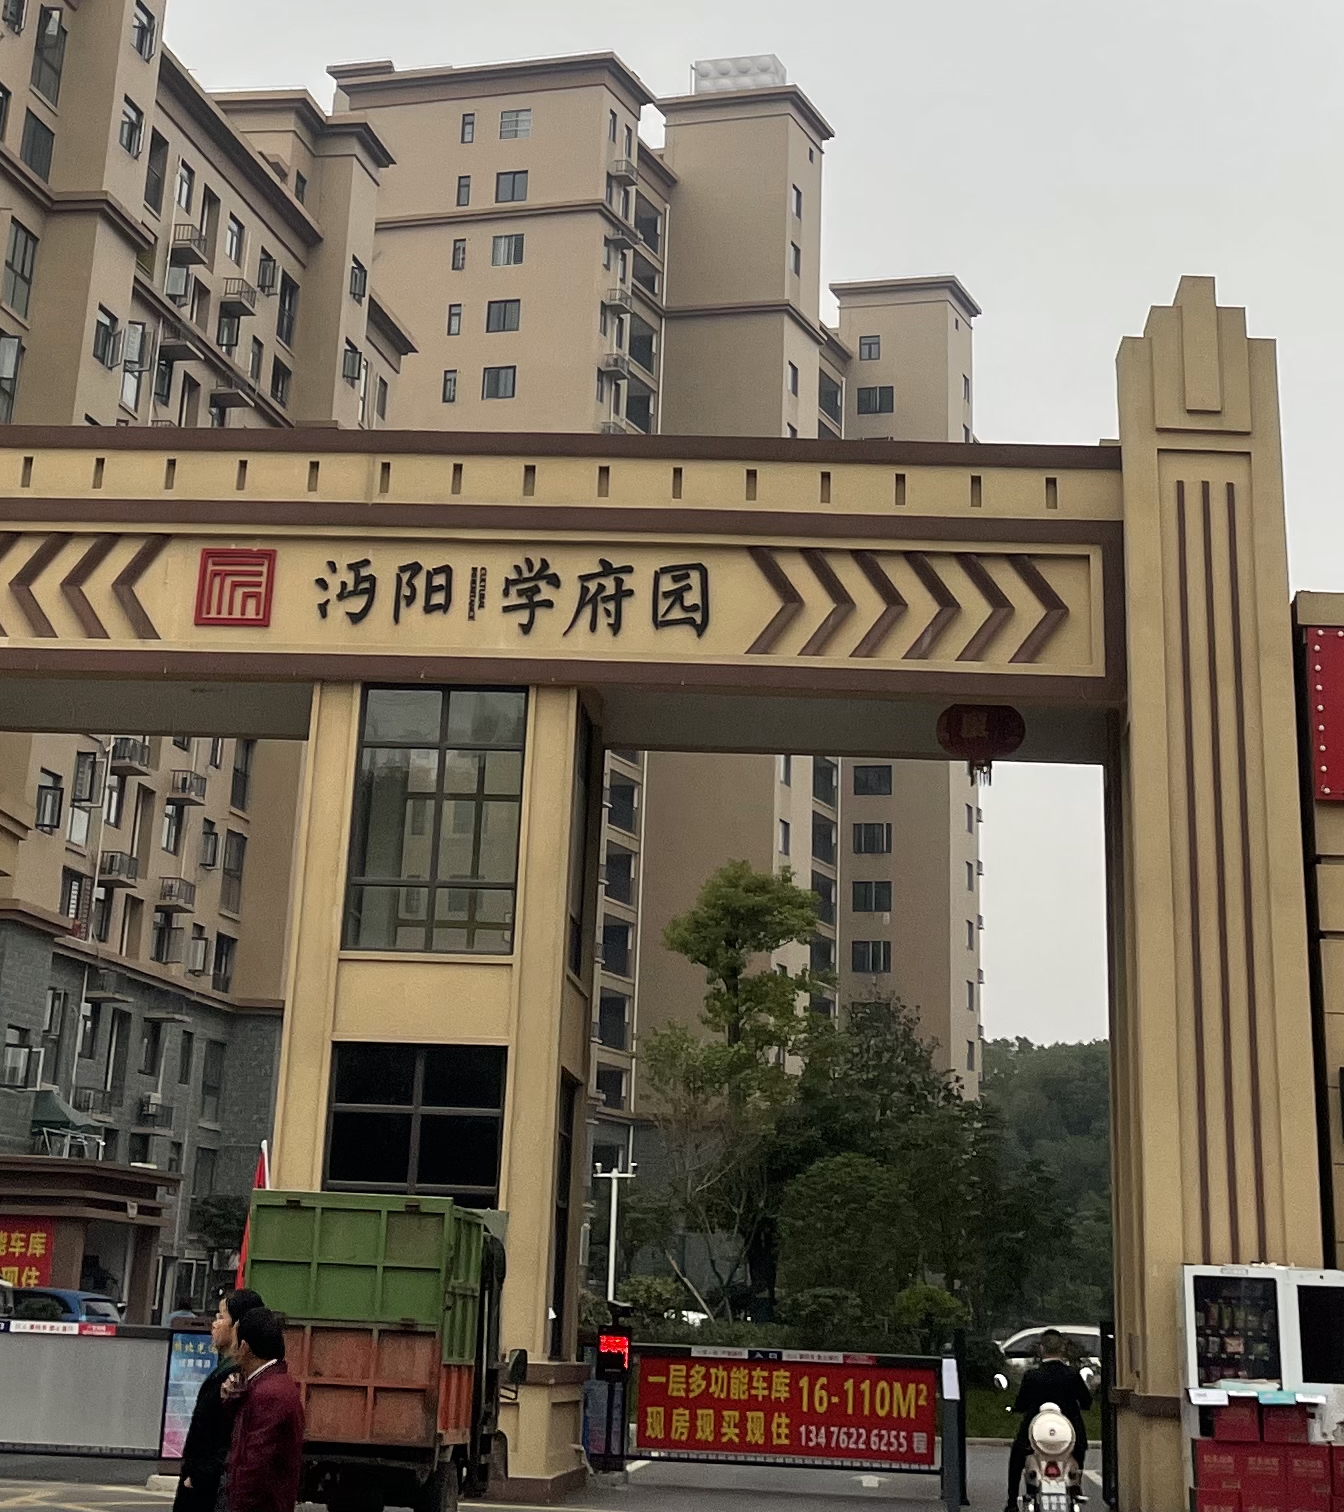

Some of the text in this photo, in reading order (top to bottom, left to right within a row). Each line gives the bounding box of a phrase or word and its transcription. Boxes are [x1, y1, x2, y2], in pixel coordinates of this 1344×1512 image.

[315, 557, 710, 638] 沔阳 学府园
[647, 1364, 791, 1403] 一层多功能车库
[645, 1406, 791, 1446] 现房现买现住
